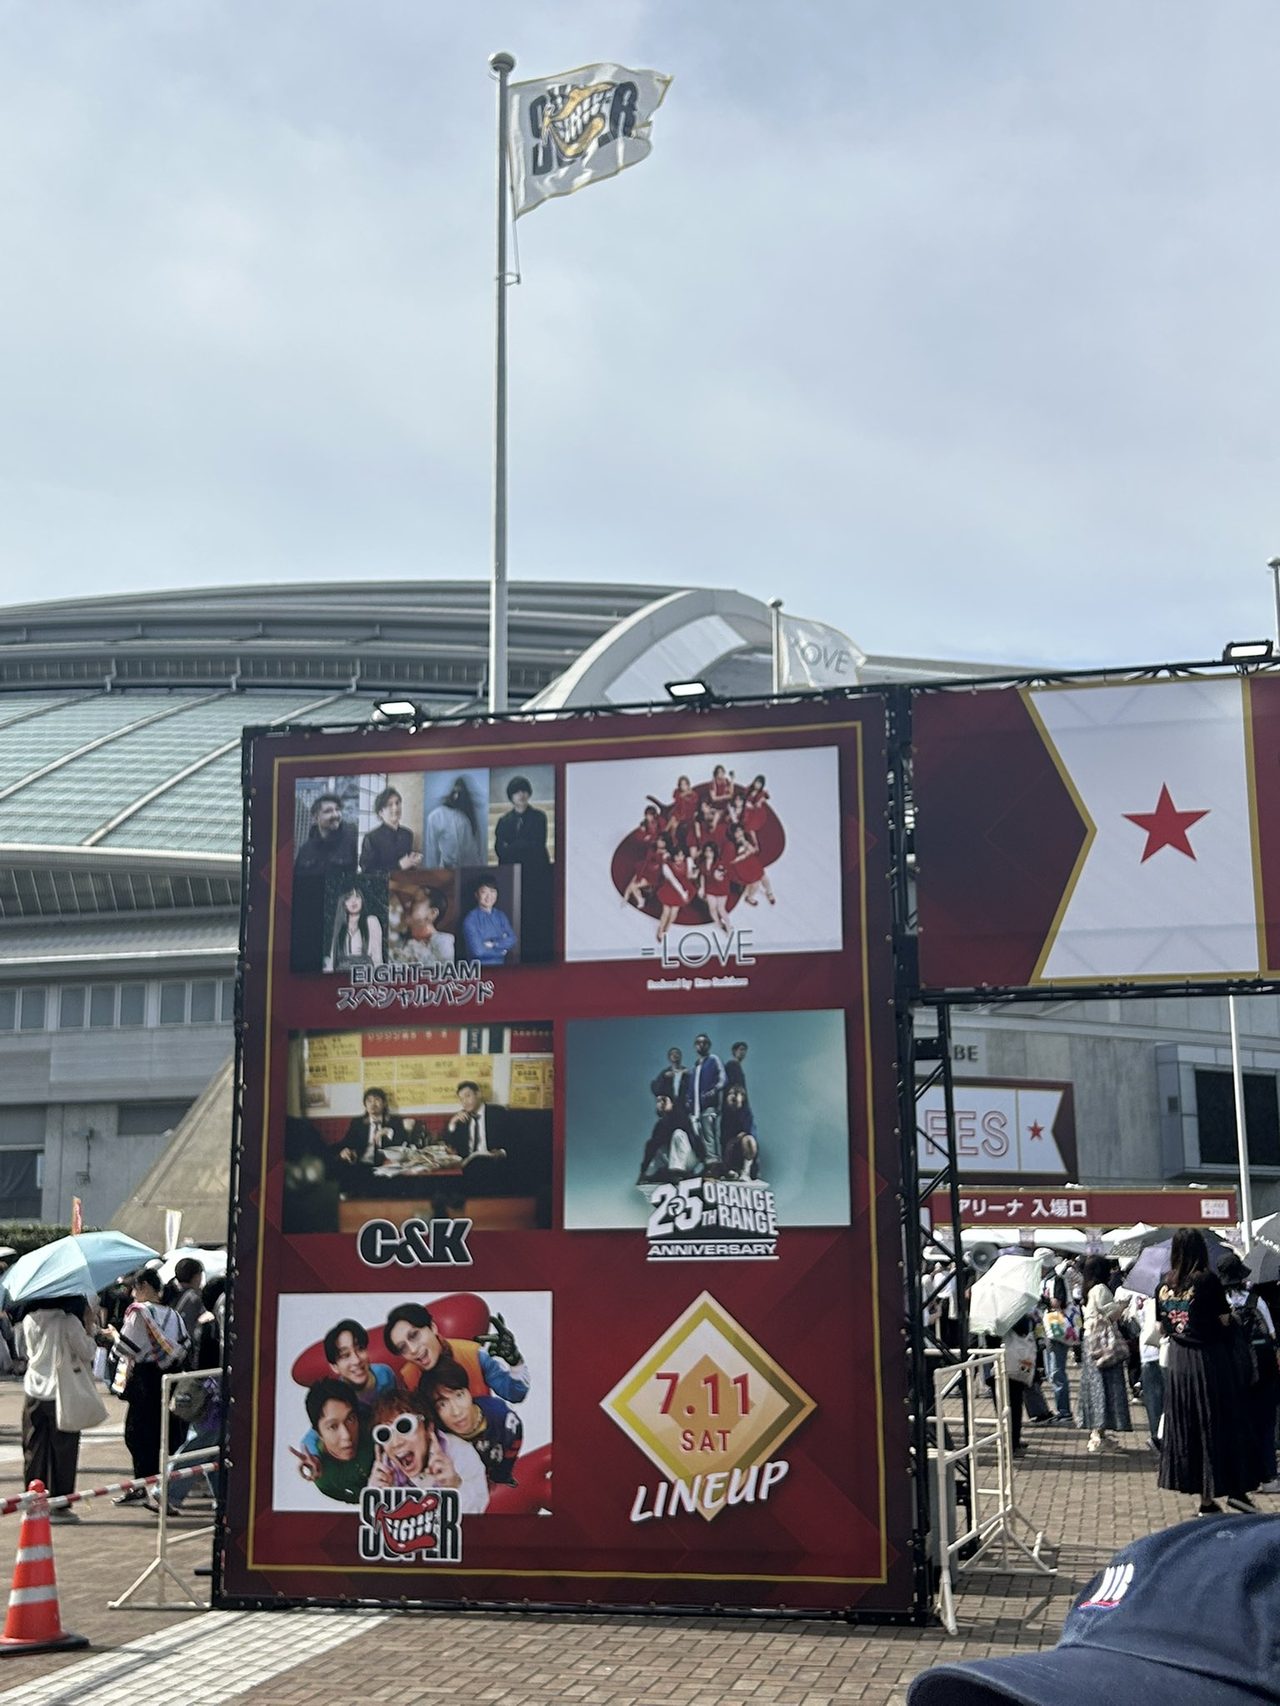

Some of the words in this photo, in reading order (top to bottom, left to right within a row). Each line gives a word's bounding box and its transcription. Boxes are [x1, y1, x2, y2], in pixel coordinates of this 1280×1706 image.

[351, 960, 481, 984] EIGHT-JAM
[336, 980, 494, 1009] スペシャルバンド
[925, 1110, 1010, 1157] FES
[703, 1181, 777, 1213] ORANGE
[1031, 1198, 1088, 1218] 入場口
[718, 1204, 780, 1236] RANGE
[358, 1219, 473, 1267] C&K
[647, 1243, 777, 1256] ANNIVERSARY
[655, 1372, 749, 1415] 7.11
[681, 1429, 731, 1452] SAT
[630, 1460, 789, 1522] LINEUP
